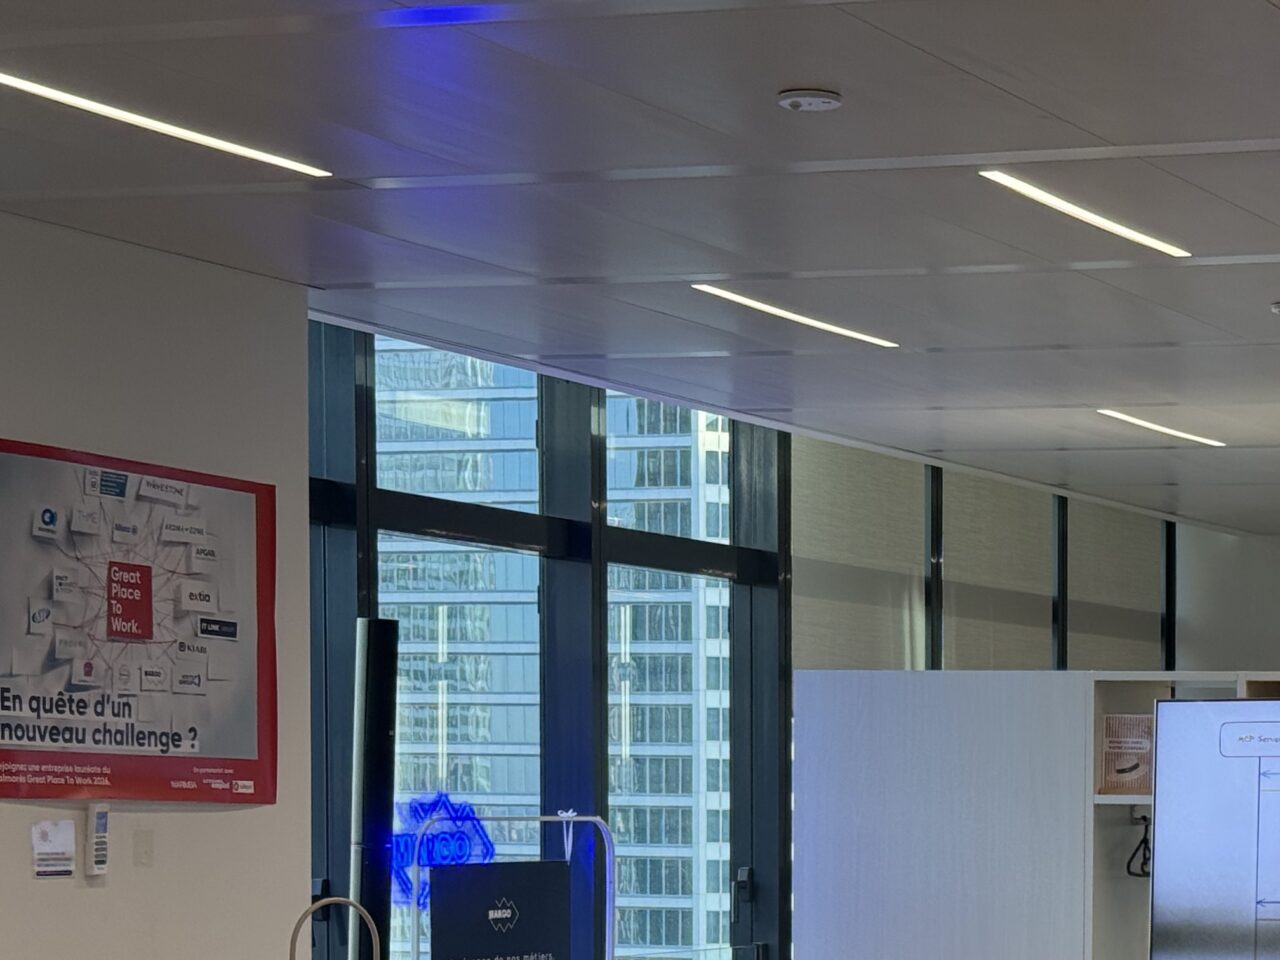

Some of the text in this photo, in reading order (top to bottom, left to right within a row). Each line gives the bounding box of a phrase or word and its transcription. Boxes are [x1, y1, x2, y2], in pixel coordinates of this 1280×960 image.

[111, 566, 141, 584] Great
[111, 583, 141, 600] Place
[111, 600, 122, 615] To
[0, 687, 132, 719] En quête d'un
[0, 721, 198, 754] nouveau challenge ?
